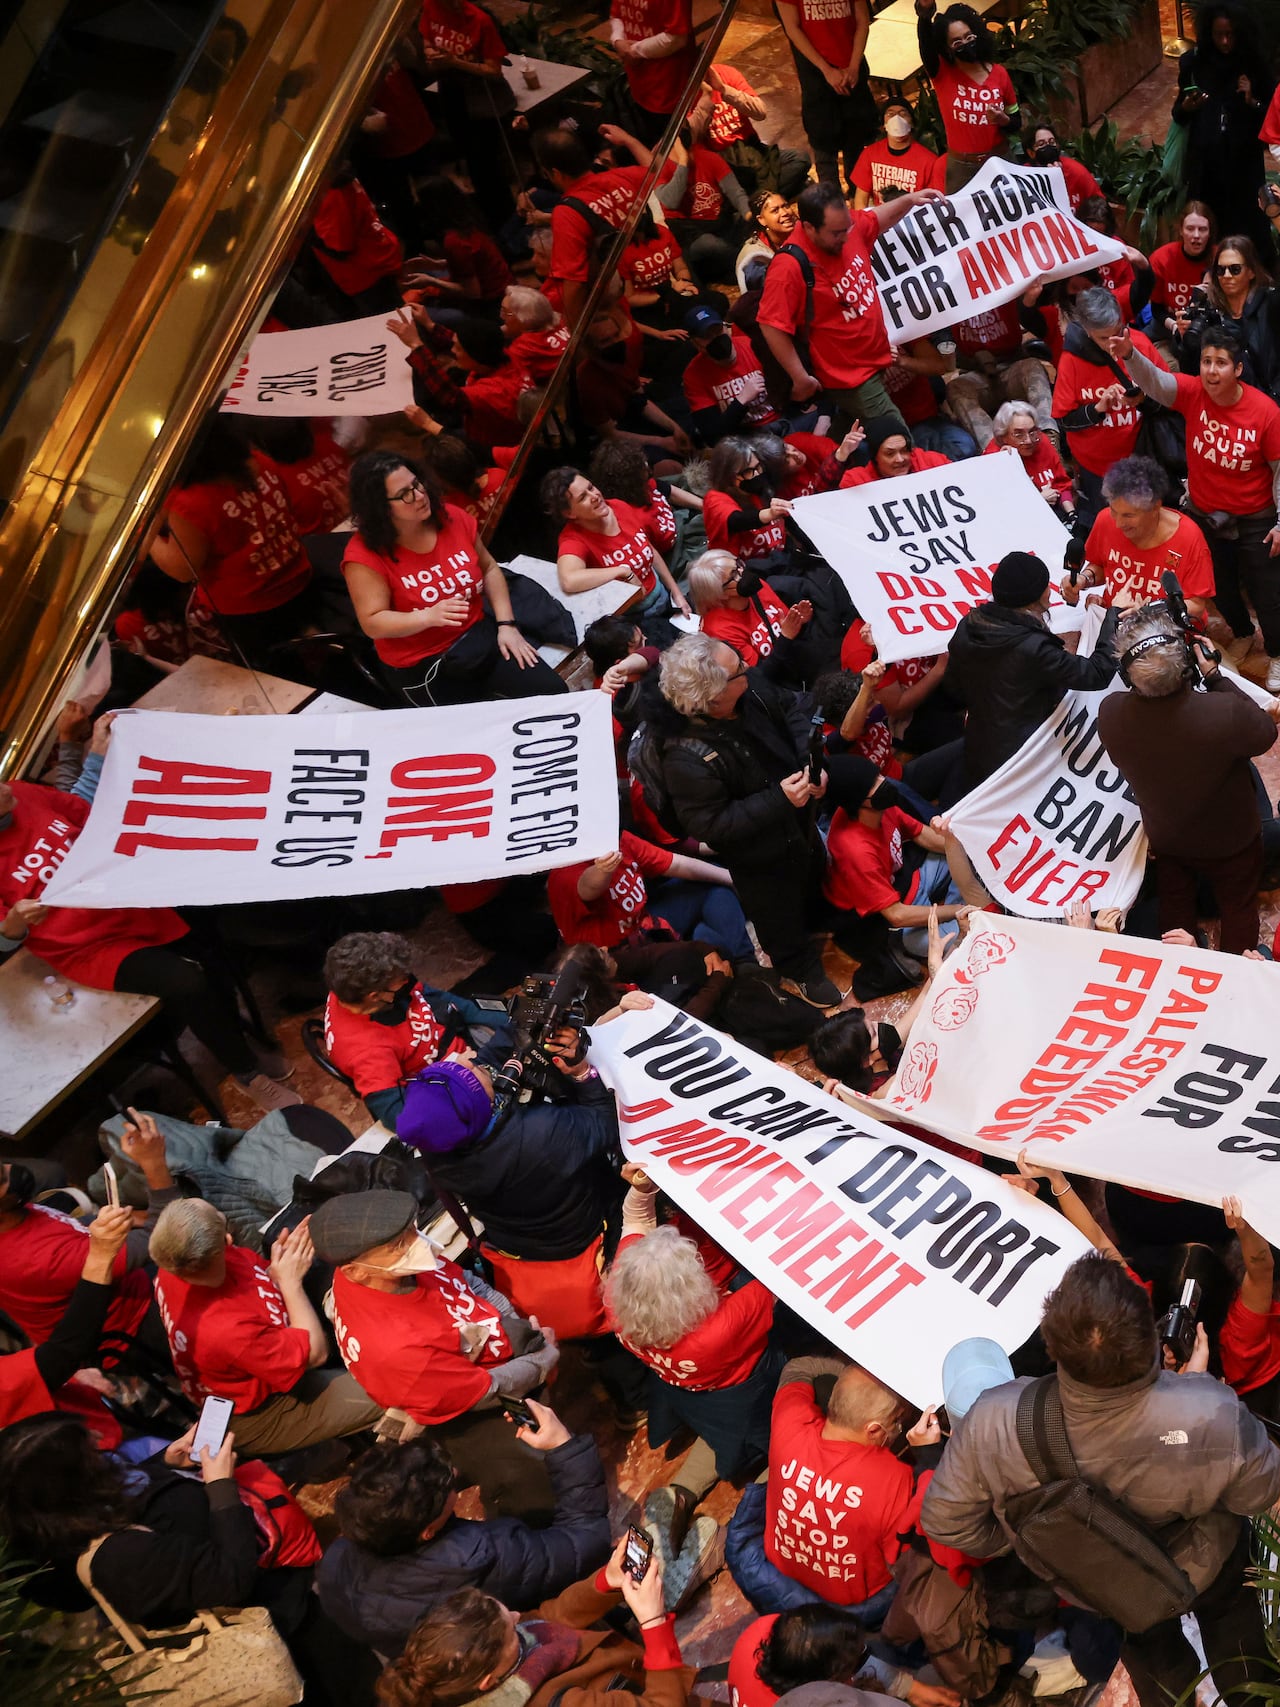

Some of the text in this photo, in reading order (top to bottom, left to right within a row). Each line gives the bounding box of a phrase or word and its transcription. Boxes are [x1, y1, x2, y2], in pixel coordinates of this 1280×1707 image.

[803, 3, 852, 20] FASCISM
[957, 84, 1001, 101] STOP
[953, 111, 990, 126] ISRA
[871, 162, 917, 181] VETERANS
[871, 172, 1062, 286] NEVER AGAIN
[634, 247, 671, 271] STOP
[881, 212, 1099, 329] FOR ANYONE
[832, 273, 855, 298] NOT
[845, 274, 872, 305] OUR
[1199, 409, 1257, 443] NOT IN
[1202, 430, 1247, 458] OUR
[1192, 435, 1254, 473] NAME
[867, 485, 978, 543] JEWS
[400, 550, 472, 589] NOT IN
[602, 543, 633, 567] NOT
[899, 530, 977, 574] SAY
[1108, 548, 1142, 575] NOT
[419, 571, 474, 603] OUR
[875, 571, 947, 601] DO
[1113, 568, 1162, 595] OUR
[1129, 634, 1167, 657] TASCAM
[113, 755, 272, 857] ALL
[364, 752, 498, 860] ONE,
[504, 712, 581, 862] COME FOR
[271, 749, 370, 868] FACE US
[1033, 776, 1141, 862] BAN
[10, 818, 71, 883] NOT IN
[986, 813, 1111, 908] EVER
[530, 1048, 550, 1067] SONY
[974, 947, 1164, 1144] FREEDOM
[1022, 964, 1224, 1144] PALESTINIAN
[1139, 1042, 1268, 1130] FOR
[622, 1008, 1062, 1309] YOU CAN'T DEPORT
[620, 1096, 675, 1148] A
[648, 1118, 928, 1332] MOVEMENT
[780, 1459, 864, 1509] JEWS
[781, 1487, 847, 1530] SAY
[774, 1525, 857, 1566] ARMING
[777, 1509, 849, 1550] STOP
[772, 1536, 858, 1584] ISRAEL
